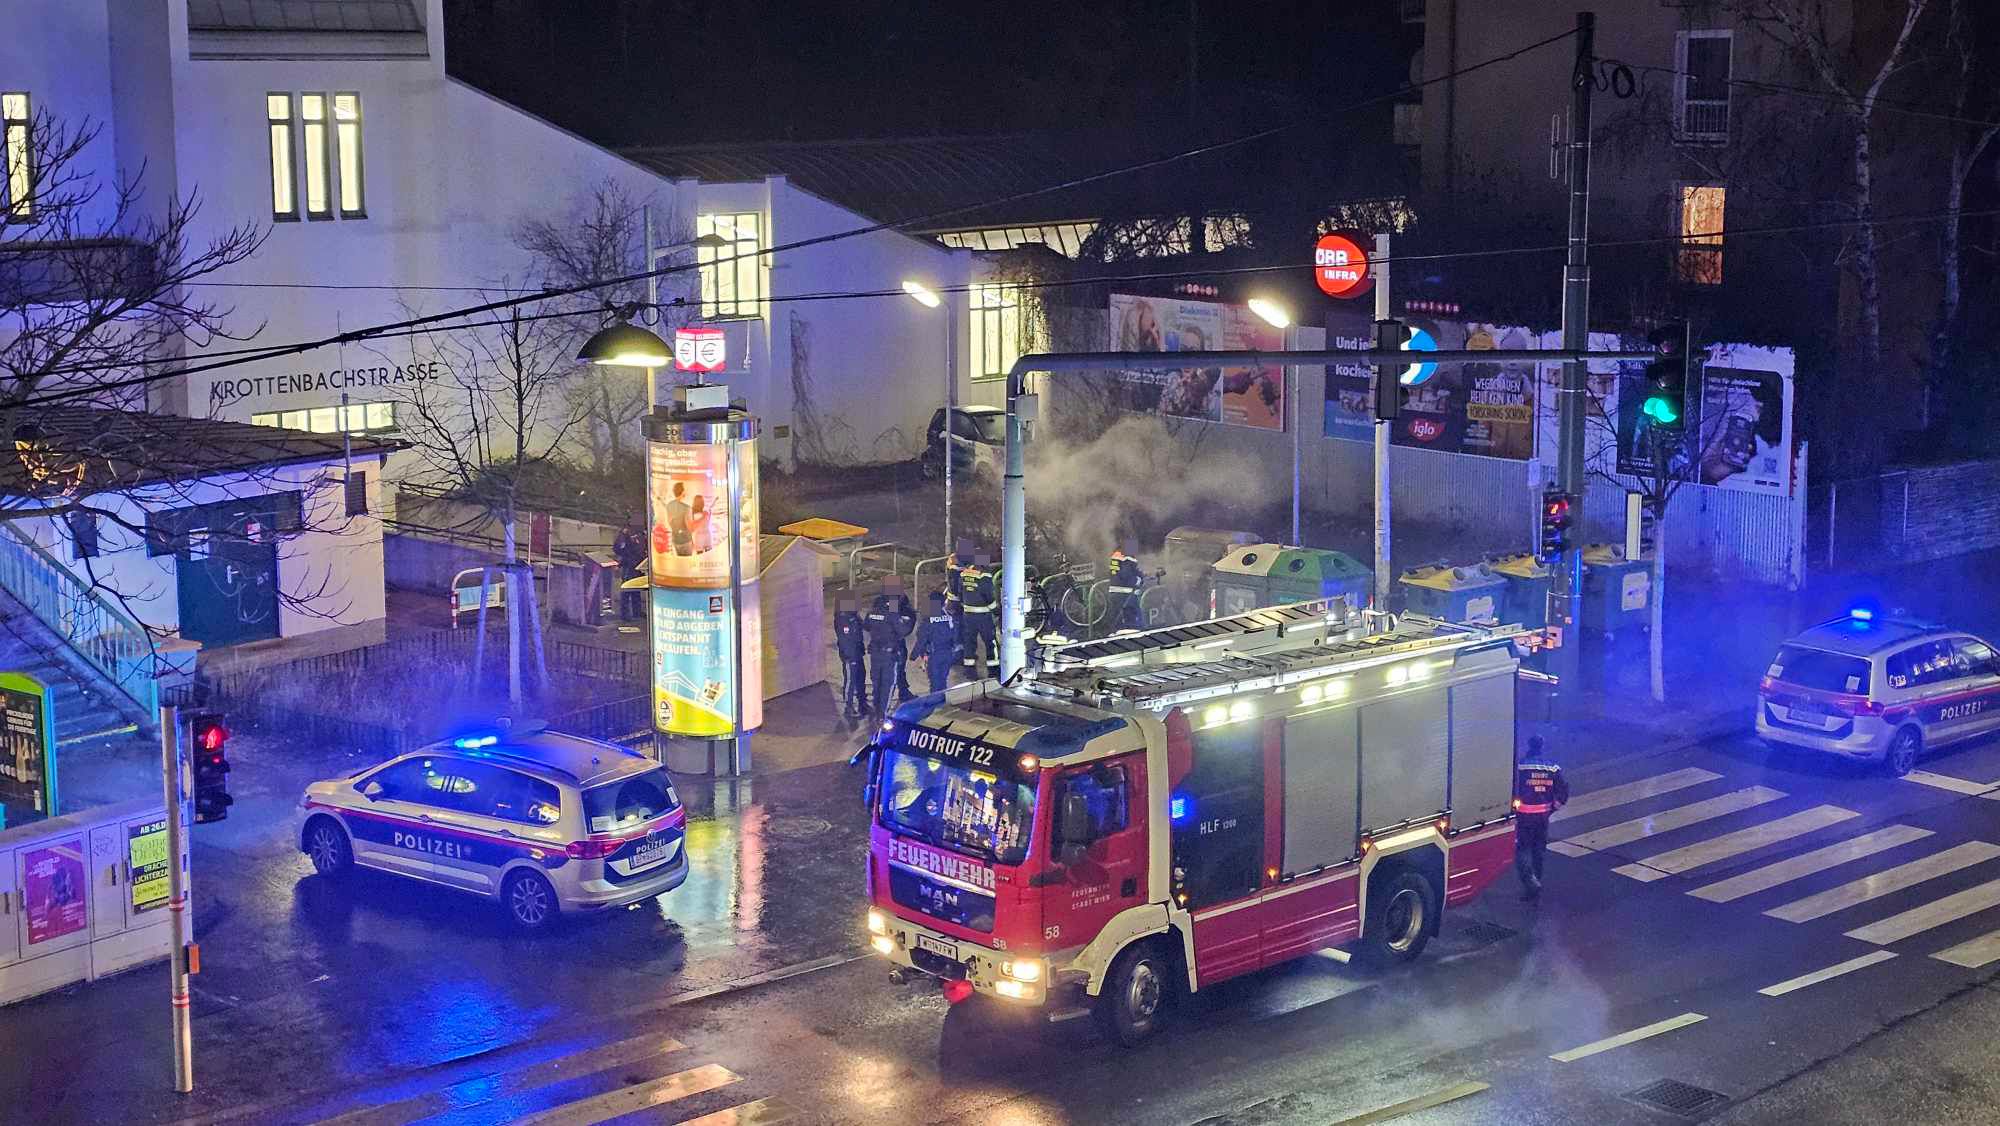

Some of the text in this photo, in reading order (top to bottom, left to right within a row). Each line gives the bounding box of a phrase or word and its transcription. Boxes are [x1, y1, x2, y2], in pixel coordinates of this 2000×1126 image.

[1325, 270, 1358, 281] INFRA
[1336, 336, 1357, 350] Und
[211, 363, 439, 399] KROTTENBACHSTRASSE
[1414, 421, 1435, 437] iglo
[1940, 701, 1982, 721] POLIZEI
[907, 729, 994, 766] NOTRUF 122
[140, 825, 150, 834] AB
[1200, 819, 1220, 835] HLF
[394, 831, 461, 859] POLIZEI
[636, 838, 665, 854] POLIZEI
[888, 838, 996, 889] FEUERWEHR
[919, 884, 958, 906] MAN
[1045, 925, 1060, 940] 58
[992, 937, 1007, 950] 58
